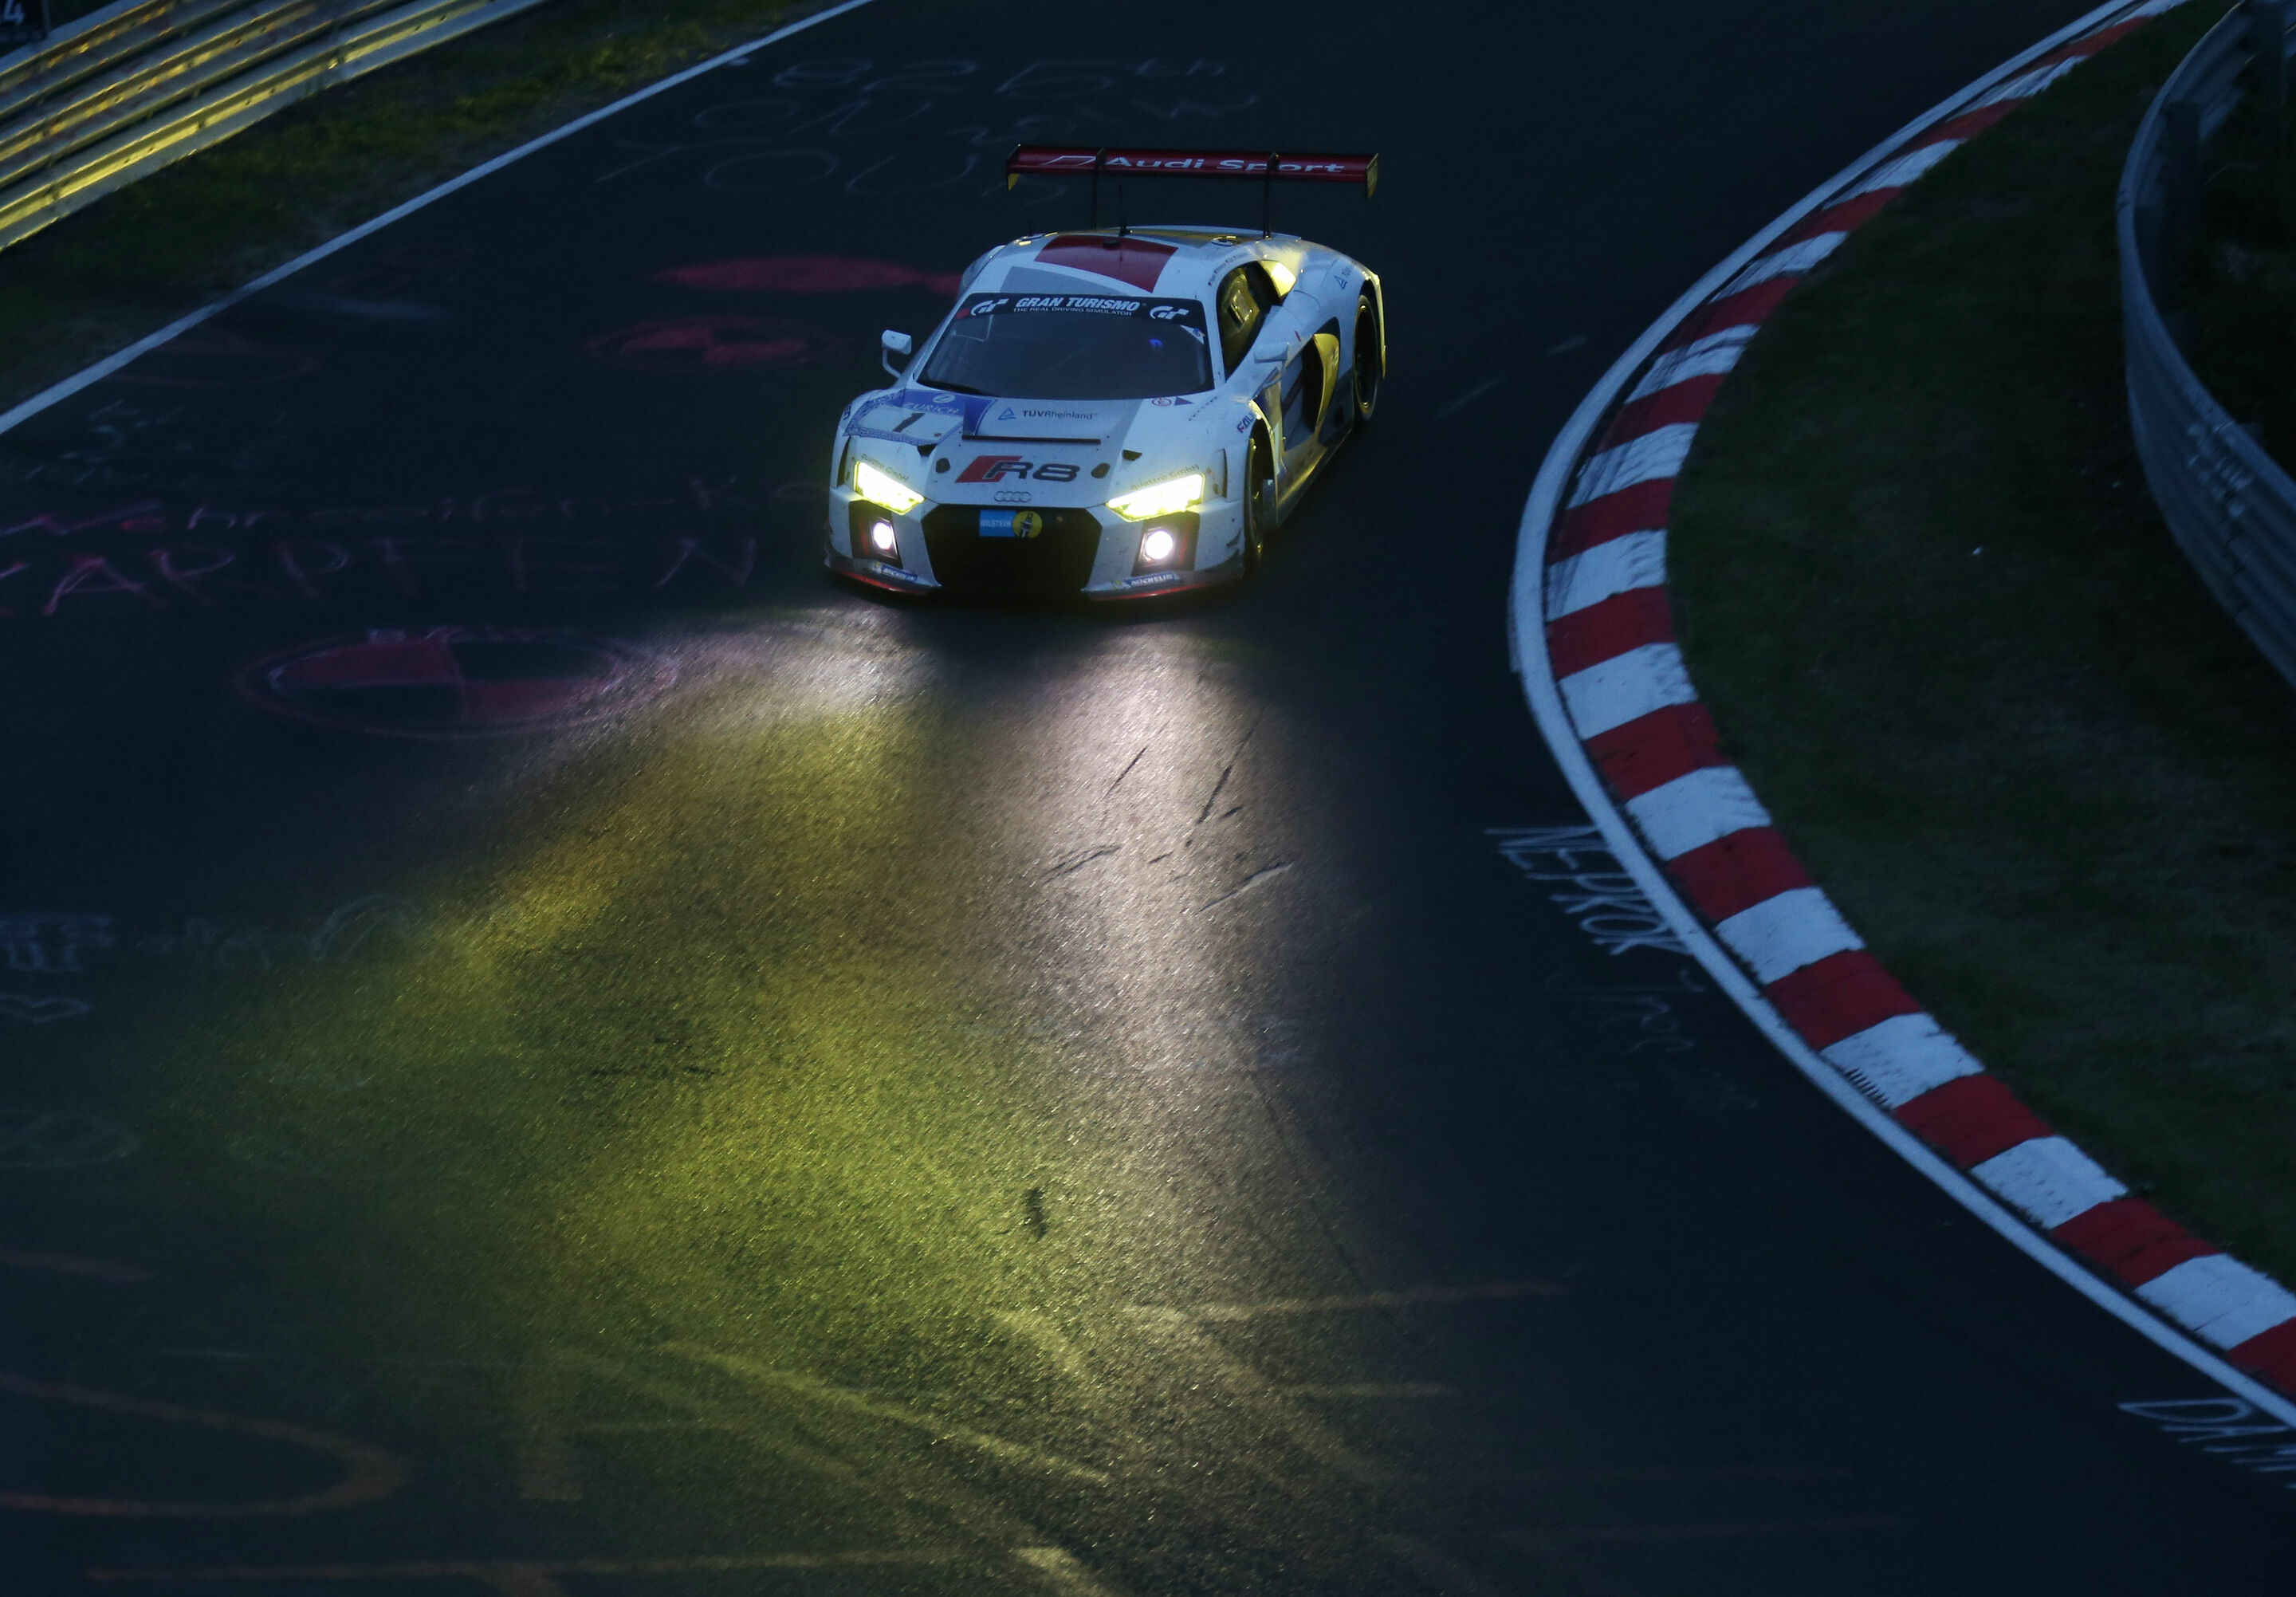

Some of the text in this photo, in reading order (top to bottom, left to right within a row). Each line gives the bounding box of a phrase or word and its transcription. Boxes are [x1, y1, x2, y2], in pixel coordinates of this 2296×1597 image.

[1105, 156, 1345, 173] Audi Sport
[1016, 297, 1141, 312] GRAN TURISMO
[1085, 308, 1132, 317] SIMULATOR
[904, 403, 960, 413] ZURICH
[892, 412, 926, 433] 1
[984, 460, 1080, 482] R8
[1130, 572, 1173, 586] MICHELIN
